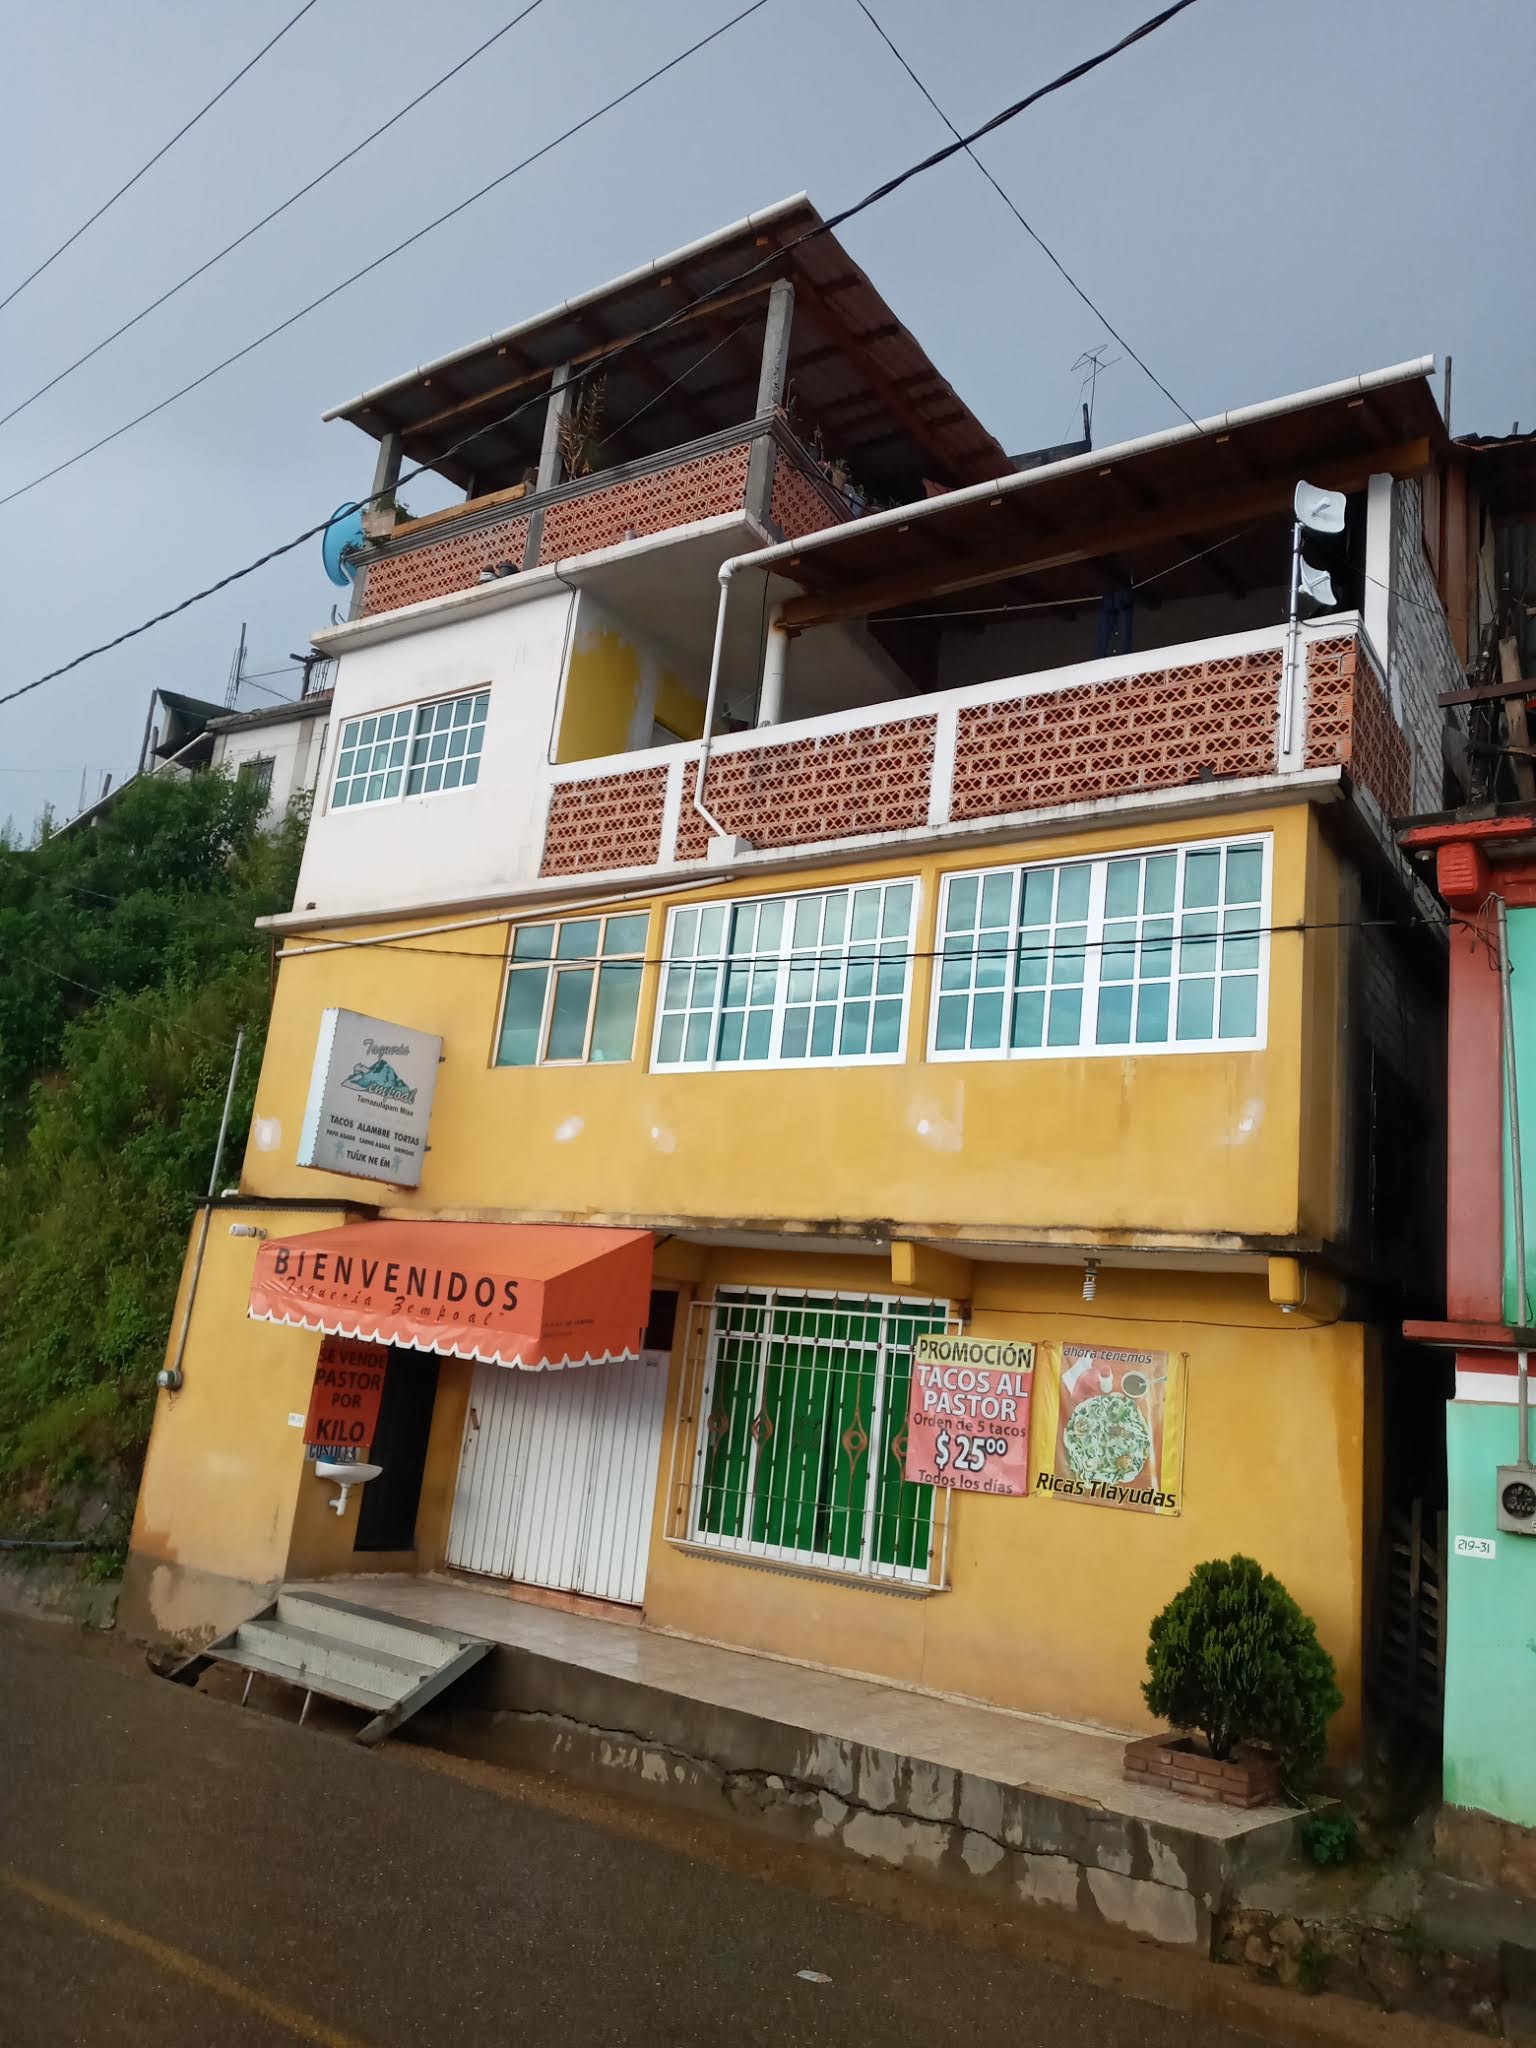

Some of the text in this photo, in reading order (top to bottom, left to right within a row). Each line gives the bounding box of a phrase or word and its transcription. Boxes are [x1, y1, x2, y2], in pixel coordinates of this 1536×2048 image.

[357, 1094, 399, 1112] Tamazulapam
[330, 1115, 420, 1146] TACOS ALAMBRE TORTAS
[359, 1137, 375, 1147] CARNE
[367, 1155, 379, 1166] NE
[274, 1247, 519, 1312] BIENVENIDOS
[319, 1347, 386, 1369] SE VENDE
[919, 1339, 1032, 1368] PROMOCIÓN
[1063, 1346, 1153, 1365] ahora tenemos
[314, 1368, 382, 1391] PASTOR
[917, 1365, 1029, 1399] TACOS AL
[331, 1393, 363, 1409] POR
[923, 1389, 1018, 1423] PASTOR
[316, 1418, 366, 1443] KILO
[913, 1412, 1027, 1438] Orden de 5 tacos
[919, 1469, 1014, 1494] Todos los días
[1036, 1472, 1178, 1508] Ricas Tlayudas
[1457, 1539, 1490, 1553] 219-31
